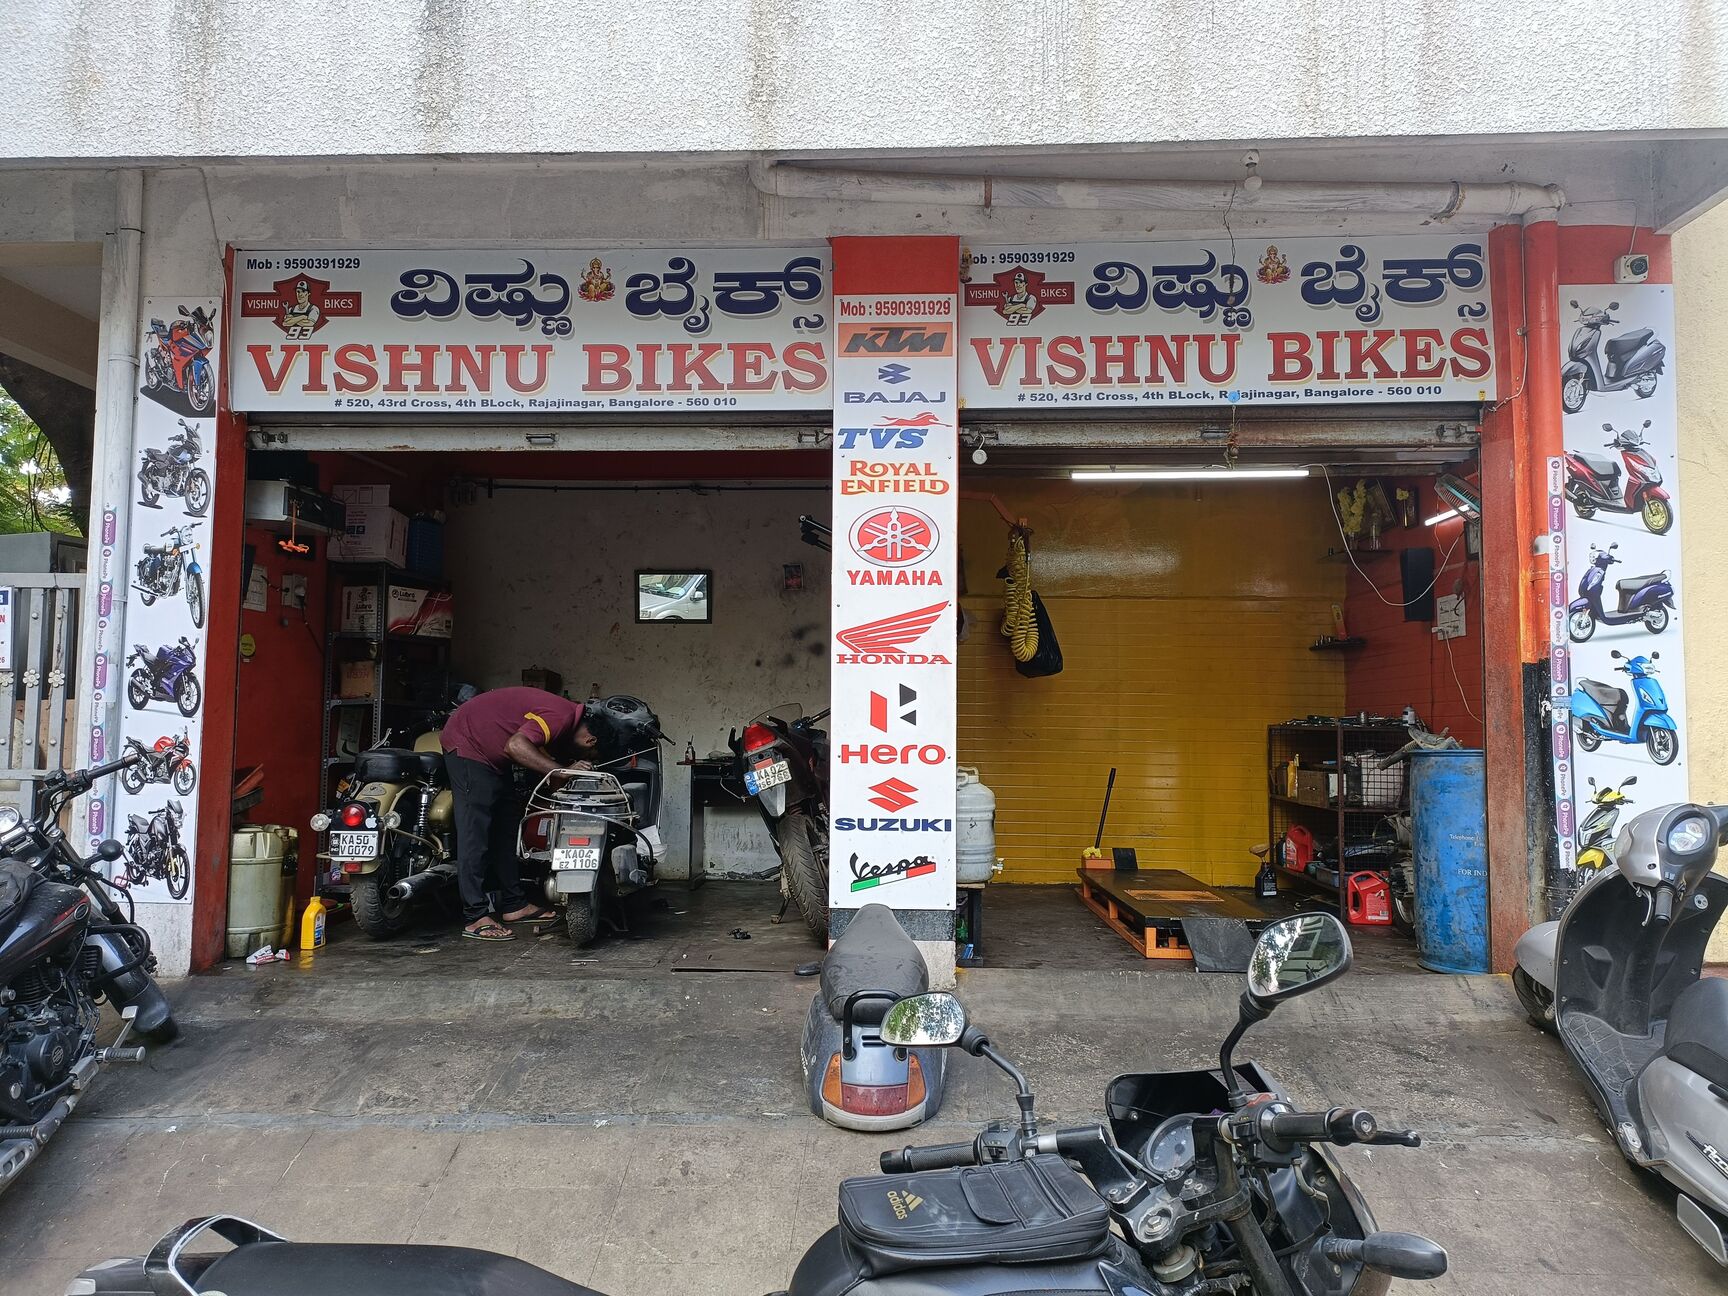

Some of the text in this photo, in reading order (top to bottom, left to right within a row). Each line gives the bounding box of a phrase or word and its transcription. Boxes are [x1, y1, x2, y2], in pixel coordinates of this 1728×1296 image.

[247, 259, 272, 270] Mob
[284, 258, 360, 269] 9590391929
[1000, 252, 1074, 264] 9590391929
[970, 288, 1067, 299] VISHNU BIKES
[248, 298, 353, 309] VISHNU BIKES
[841, 301, 866, 316] Mob
[875, 300, 950, 316] 9590391929
[1006, 313, 1032, 326] 93
[286, 326, 314, 340] 93
[844, 326, 947, 352] KTM
[970, 328, 1492, 386] VISHNU BIKES
[247, 342, 828, 392] VISHNU BIKES
[844, 392, 946, 404] BAJAJ
[1030, 393, 1057, 403] 520,
[1062, 392, 1092, 401] 43rd
[1097, 392, 1138, 402] Cross,
[1142, 391, 1163, 400] 4th
[1168, 391, 1214, 402] BLock,
[1304, 387, 1374, 399] Bangalore
[1387, 387, 1411, 395] 560
[1416, 386, 1442, 395] 010
[346, 399, 374, 408] 520,
[378, 399, 407, 407] 43rd
[411, 399, 451, 408] Cross,
[455, 399, 476, 407] 4th
[480, 398, 524, 408] BLock,
[529, 398, 605, 409] Rajajinagar,
[609, 398, 674, 408] Bangalore
[686, 398, 708, 406] 560
[712, 398, 737, 406] 010
[838, 428, 928, 449] TVS
[850, 460, 937, 477] ROYAL
[841, 480, 950, 495] ENFIELD
[847, 570, 943, 585] YAMAHA
[836, 654, 952, 664] HONDA
[834, 818, 952, 831] SUZUKI
[573, 859, 597, 868] 1106
[850, 852, 933, 884] Vespa
[887, 1191, 908, 1220] adidas
